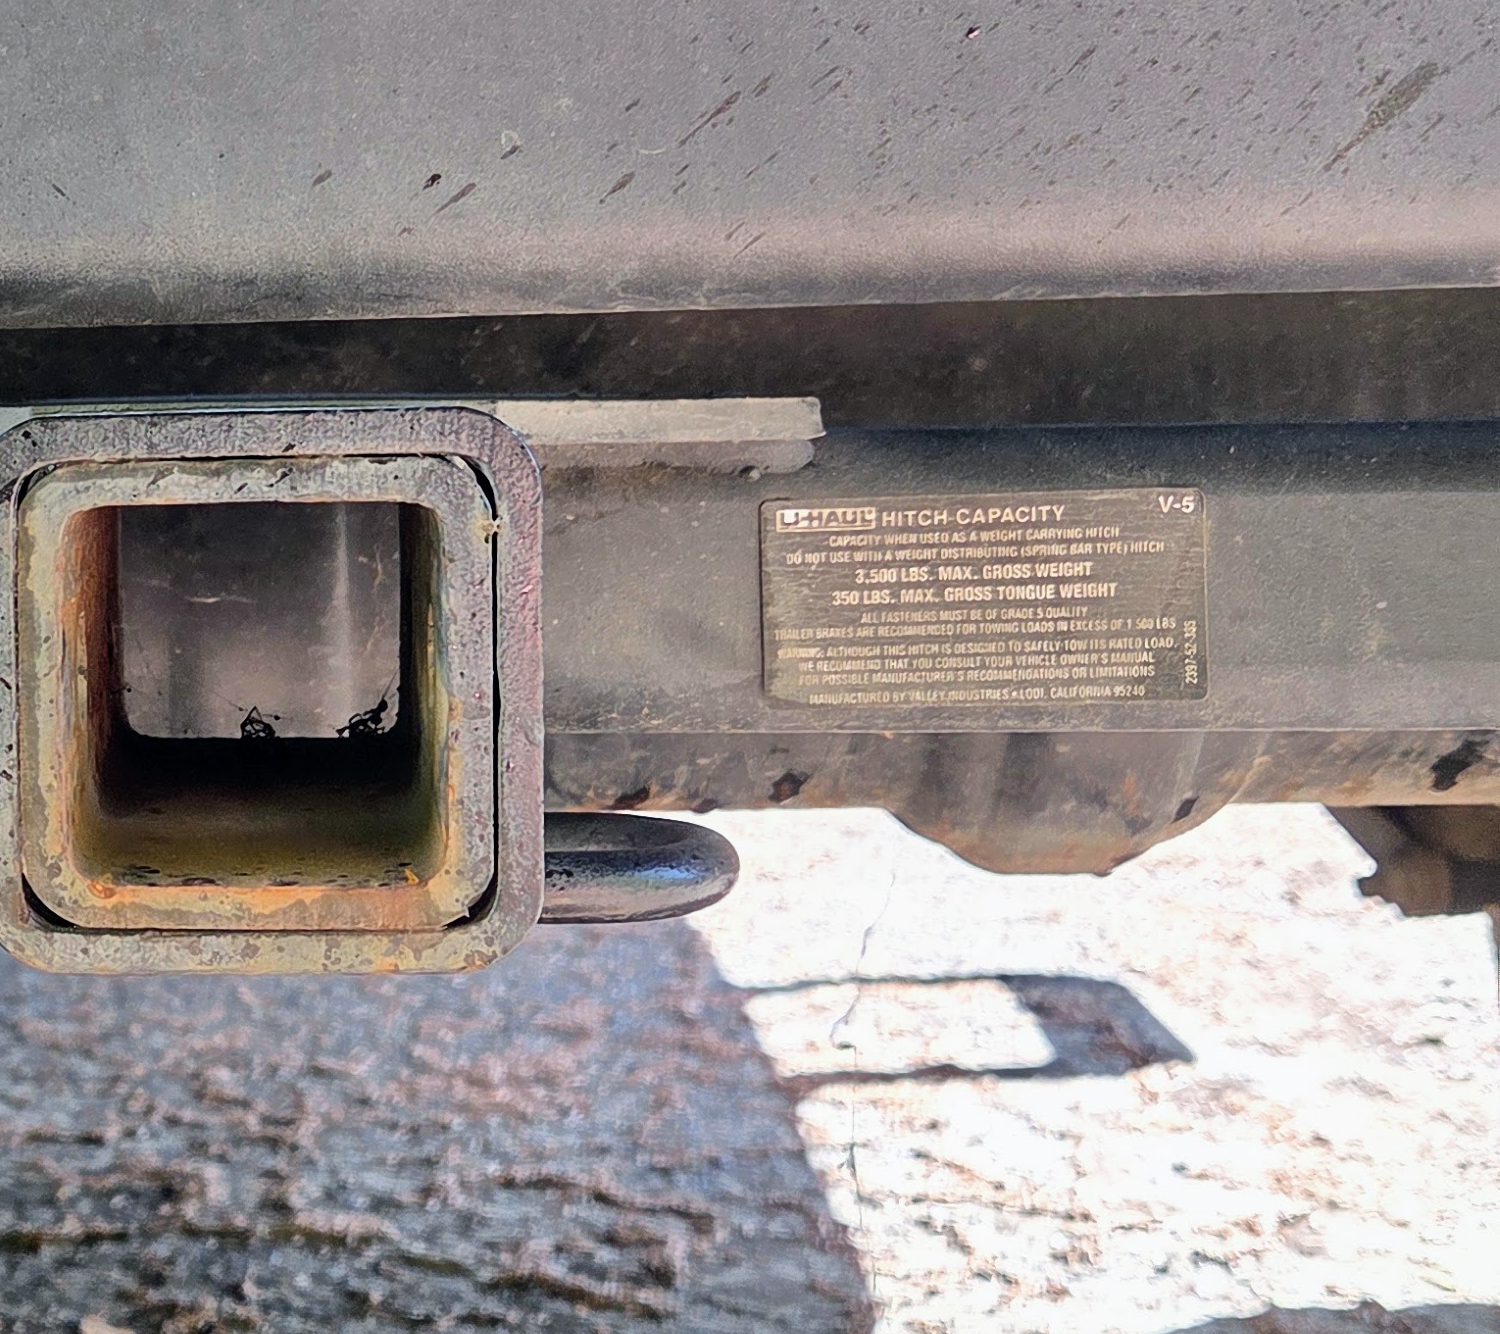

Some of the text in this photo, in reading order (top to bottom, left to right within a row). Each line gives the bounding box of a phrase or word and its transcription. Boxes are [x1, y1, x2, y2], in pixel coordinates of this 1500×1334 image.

[1158, 495, 1195, 515] V-5
[881, 508, 948, 527] HITCH
[955, 505, 1065, 525] CAPACITY
[828, 525, 1120, 547] CAPACITY WHEN USED AS A WEIGHT CARRYING HITCH
[786, 540, 1165, 565] DO NOT USE WITH A WEIGHT DISTRIBUTING (SPRING BAR TYPE) HITCH
[901, 567, 933, 582] LBS.
[938, 566, 978, 581] MAX.
[982, 564, 1031, 580] GROSS
[1036, 561, 1093, 578] WEIGHT
[832, 582, 1118, 606] 350 LBS. MAX. GROSS TONGUE WEIGHT
[861, 612, 879, 624] ALL
[881, 610, 937, 623] FASTENERS
[940, 609, 968, 622] MUST
[970, 609, 983, 620] BE
[985, 608, 998, 620] OF
[1001, 607, 1034, 620] GRADE
[1046, 606, 1088, 618] QUALITY
[774, 628, 814, 641] TRAILER
[816, 627, 854, 639] BRAKES
[856, 625, 877, 638] ARE
[878, 623, 954, 637] RECOMMENDED
[956, 622, 977, 635] FOR
[979, 621, 1019, 635] TOWING
[1021, 620, 1054, 634] LOADS
[1057, 619, 1068, 632] IN
[1070, 618, 1108, 632] EXCESS
[1110, 618, 1125, 631] OF
[826, 645, 880, 658] ALTHOUGH
[883, 644, 906, 656] THIS
[908, 643, 939, 656] HITCH
[941, 642, 952, 655] IS
[954, 641, 1006, 654] DESIGNED
[1008, 640, 1021, 653] TO
[1023, 639, 1063, 652] SAFELY
[1064, 638, 1088, 651] TOW
[1090, 637, 1107, 650] ITS
[1109, 637, 1142, 649] RATED
[798, 651, 1155, 672] WE RECOMMEND THAT YOU CONSULT YOUR VEHICLE OWNER'S MANUAL
[799, 674, 819, 686] FOR
[822, 673, 869, 685] POSSIBLE
[967, 667, 1069, 682] RECOMMENDATIONS
[1072, 666, 1087, 679] OR
[1089, 665, 1155, 679] LIMITATIONS
[809, 691, 890, 705] MANUFACTURED
[892, 691, 907, 703] BY
[909, 689, 946, 702] VALLEY
[948, 688, 1010, 701] INDUSTRIES
[1050, 685, 1111, 699] CALIFORNIA
